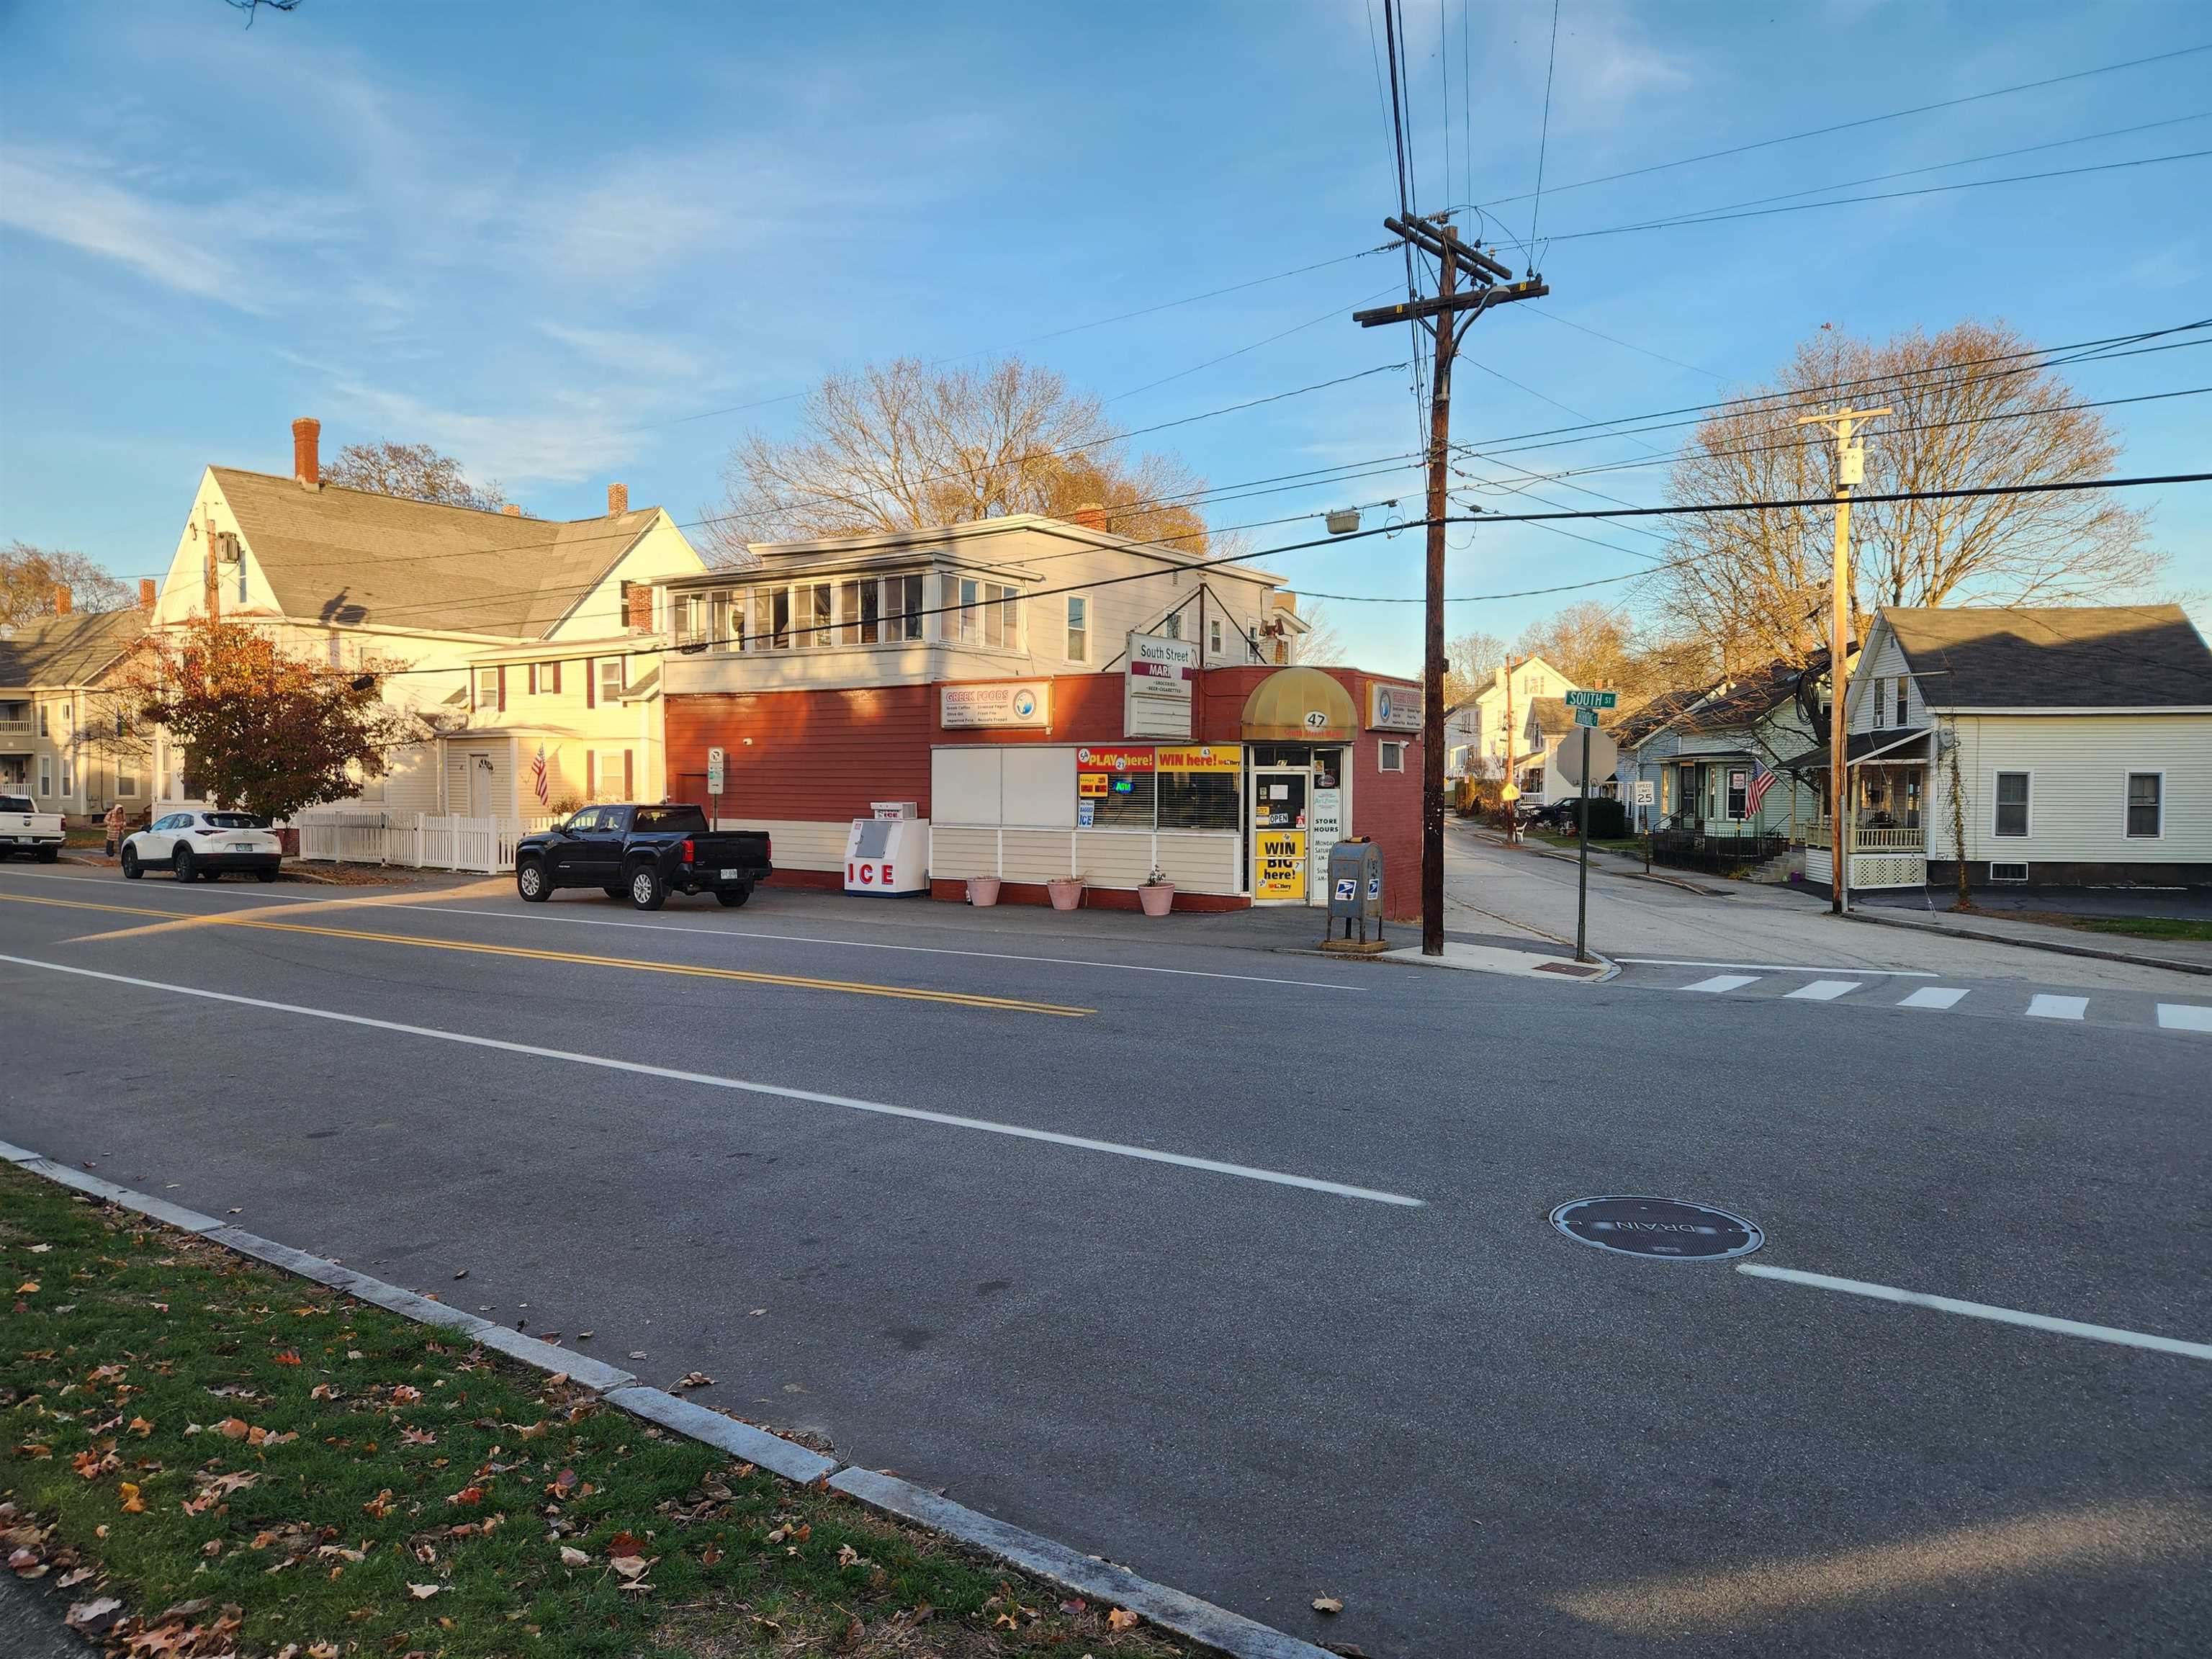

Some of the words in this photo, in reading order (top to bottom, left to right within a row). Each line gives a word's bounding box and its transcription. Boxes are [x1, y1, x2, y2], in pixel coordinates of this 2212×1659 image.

[1141, 644, 1164, 659] South
[1166, 648, 1188, 662] Street
[946, 691, 974, 702] GREEK
[977, 691, 1008, 701] FOODS
[1570, 692, 1601, 706] SOUTH
[1308, 714, 1325, 727] 47
[1089, 755, 1118, 765] PLAY
[1125, 754, 1152, 765] here!
[1159, 754, 1184, 766] WIN
[1187, 754, 1217, 766] here!
[1079, 814, 1092, 825] ICE
[1270, 814, 1287, 823] OPEN
[1264, 842, 1295, 854] WIN
[1267, 855, 1292, 868] BIG
[848, 863, 894, 884] ICE
[1264, 868, 1295, 879] here!
[1617, 1221, 1696, 1233] DRAIN
